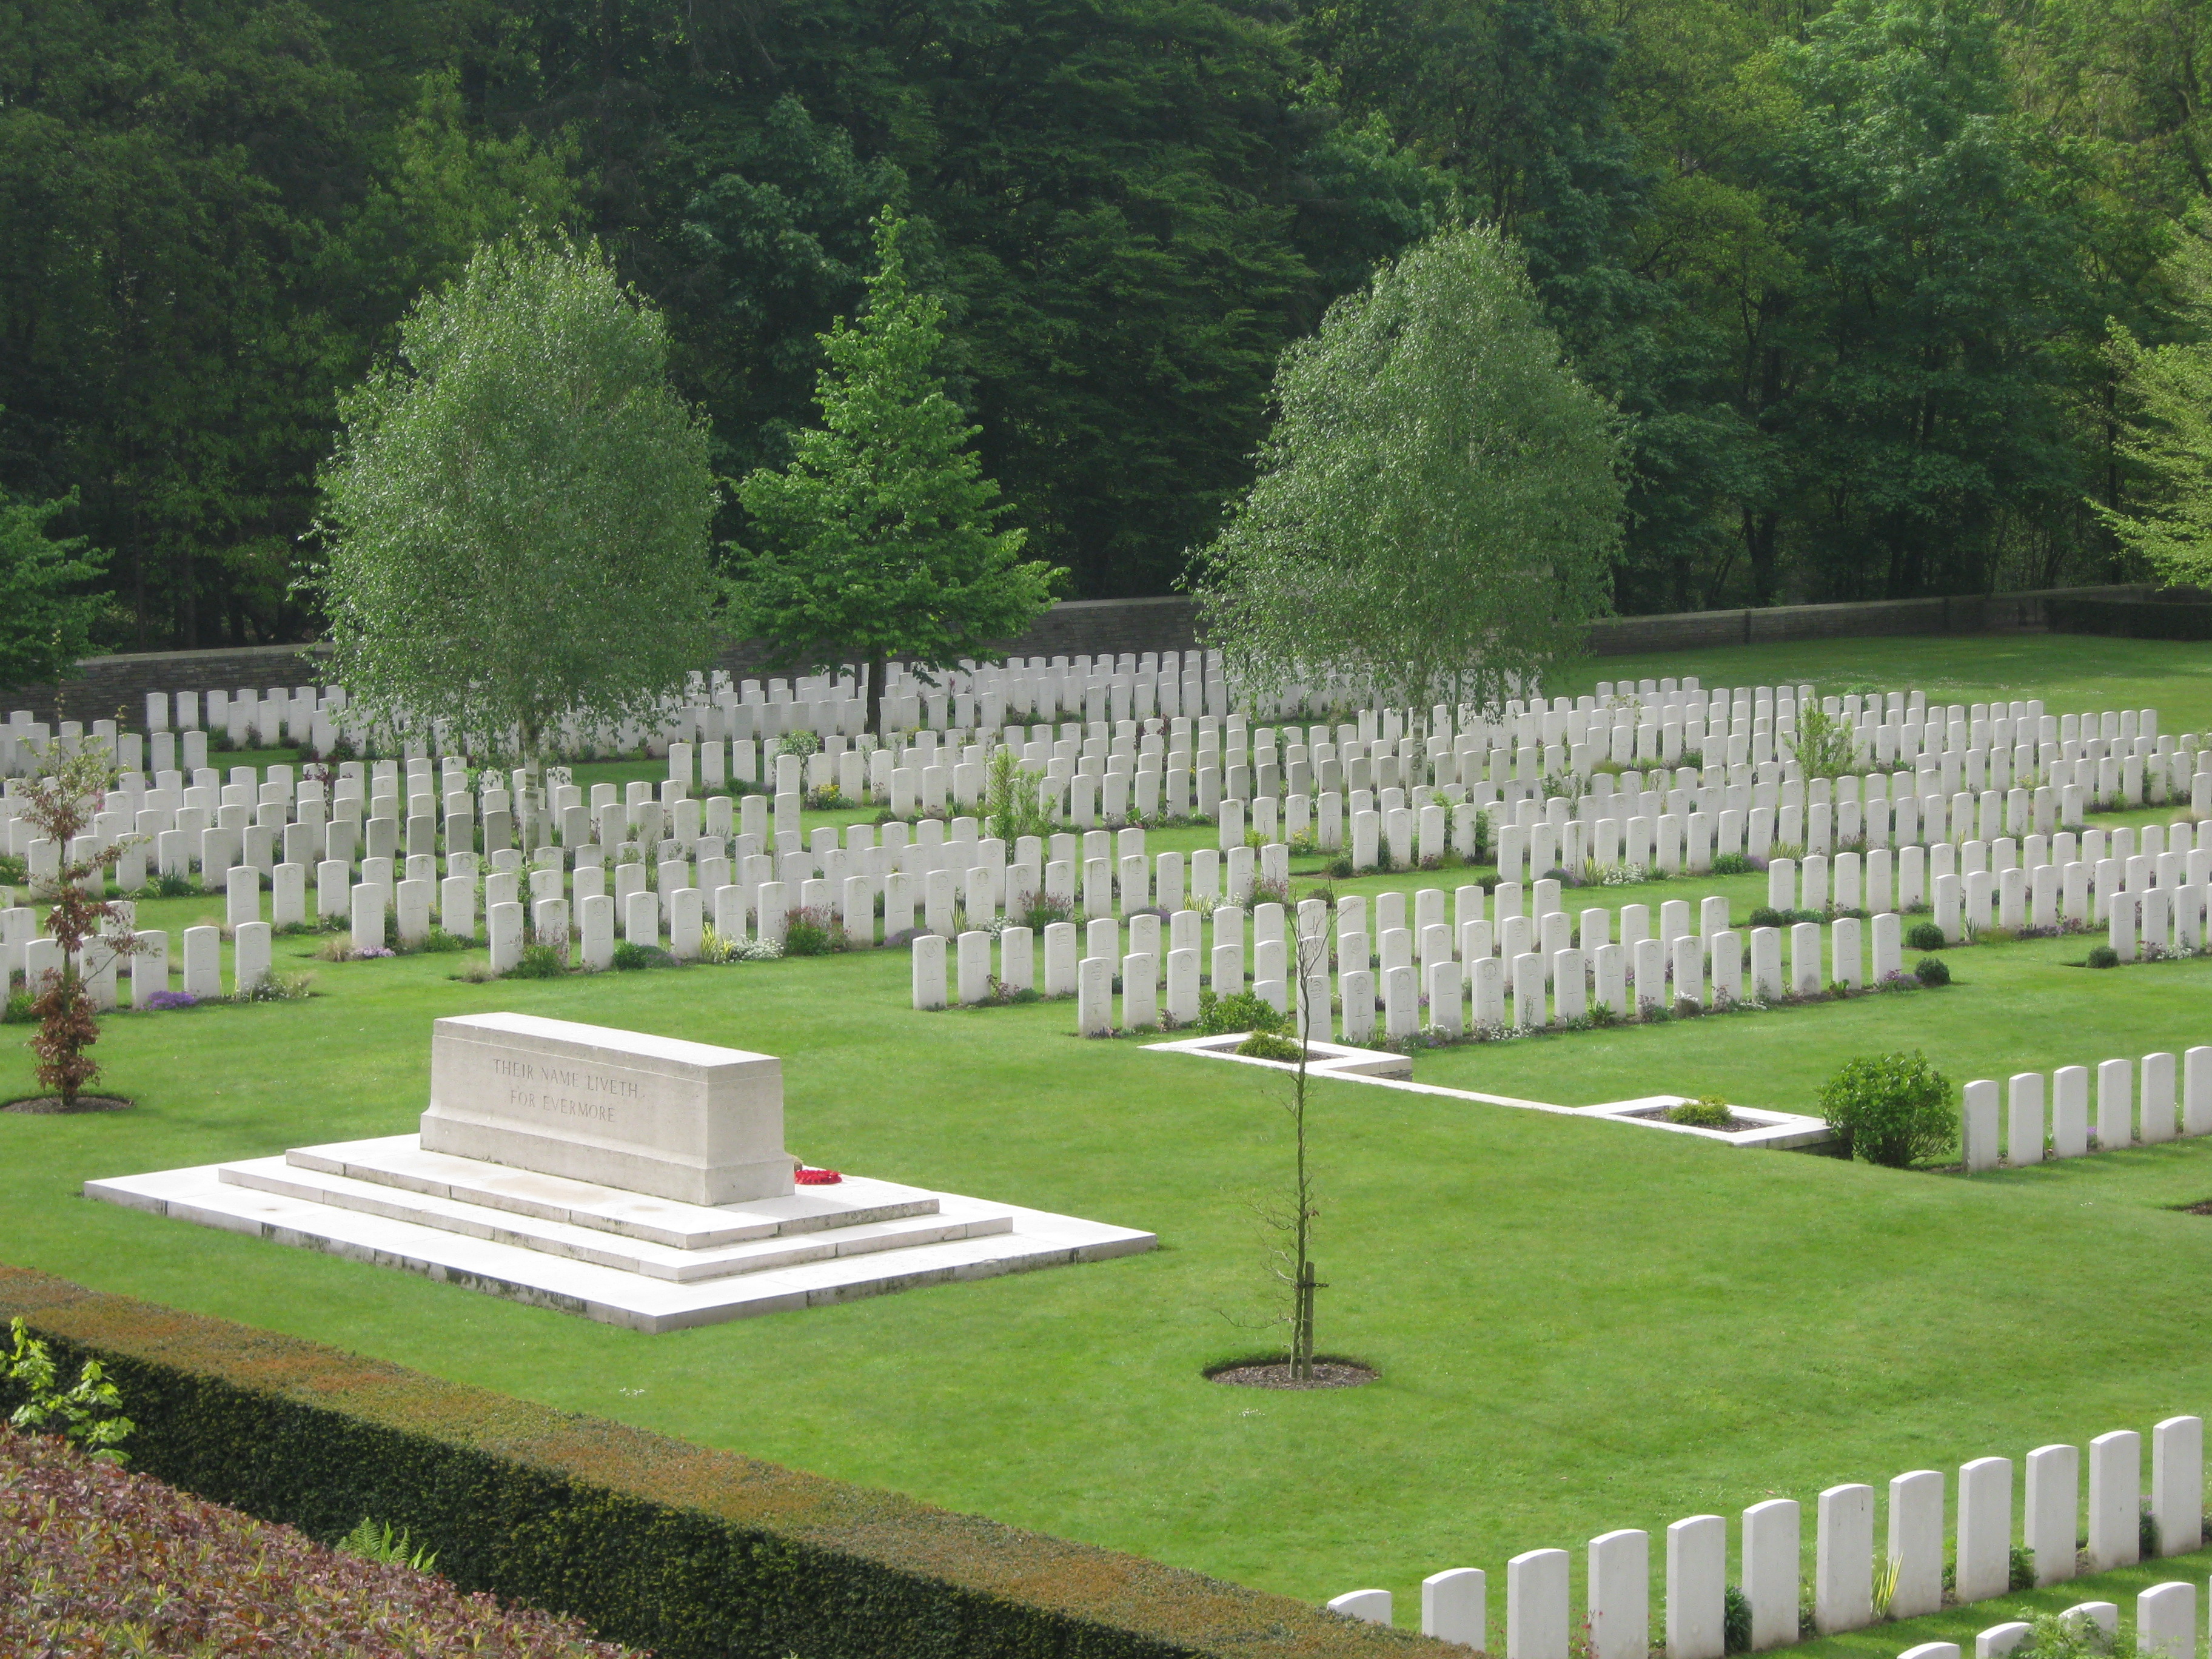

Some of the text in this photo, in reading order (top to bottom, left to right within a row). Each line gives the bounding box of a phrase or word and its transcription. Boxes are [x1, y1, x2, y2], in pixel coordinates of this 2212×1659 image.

[494, 1059, 637, 1098] THEIR NAME LIVETH
[510, 1090, 615, 1122] FOR EVERMORE
